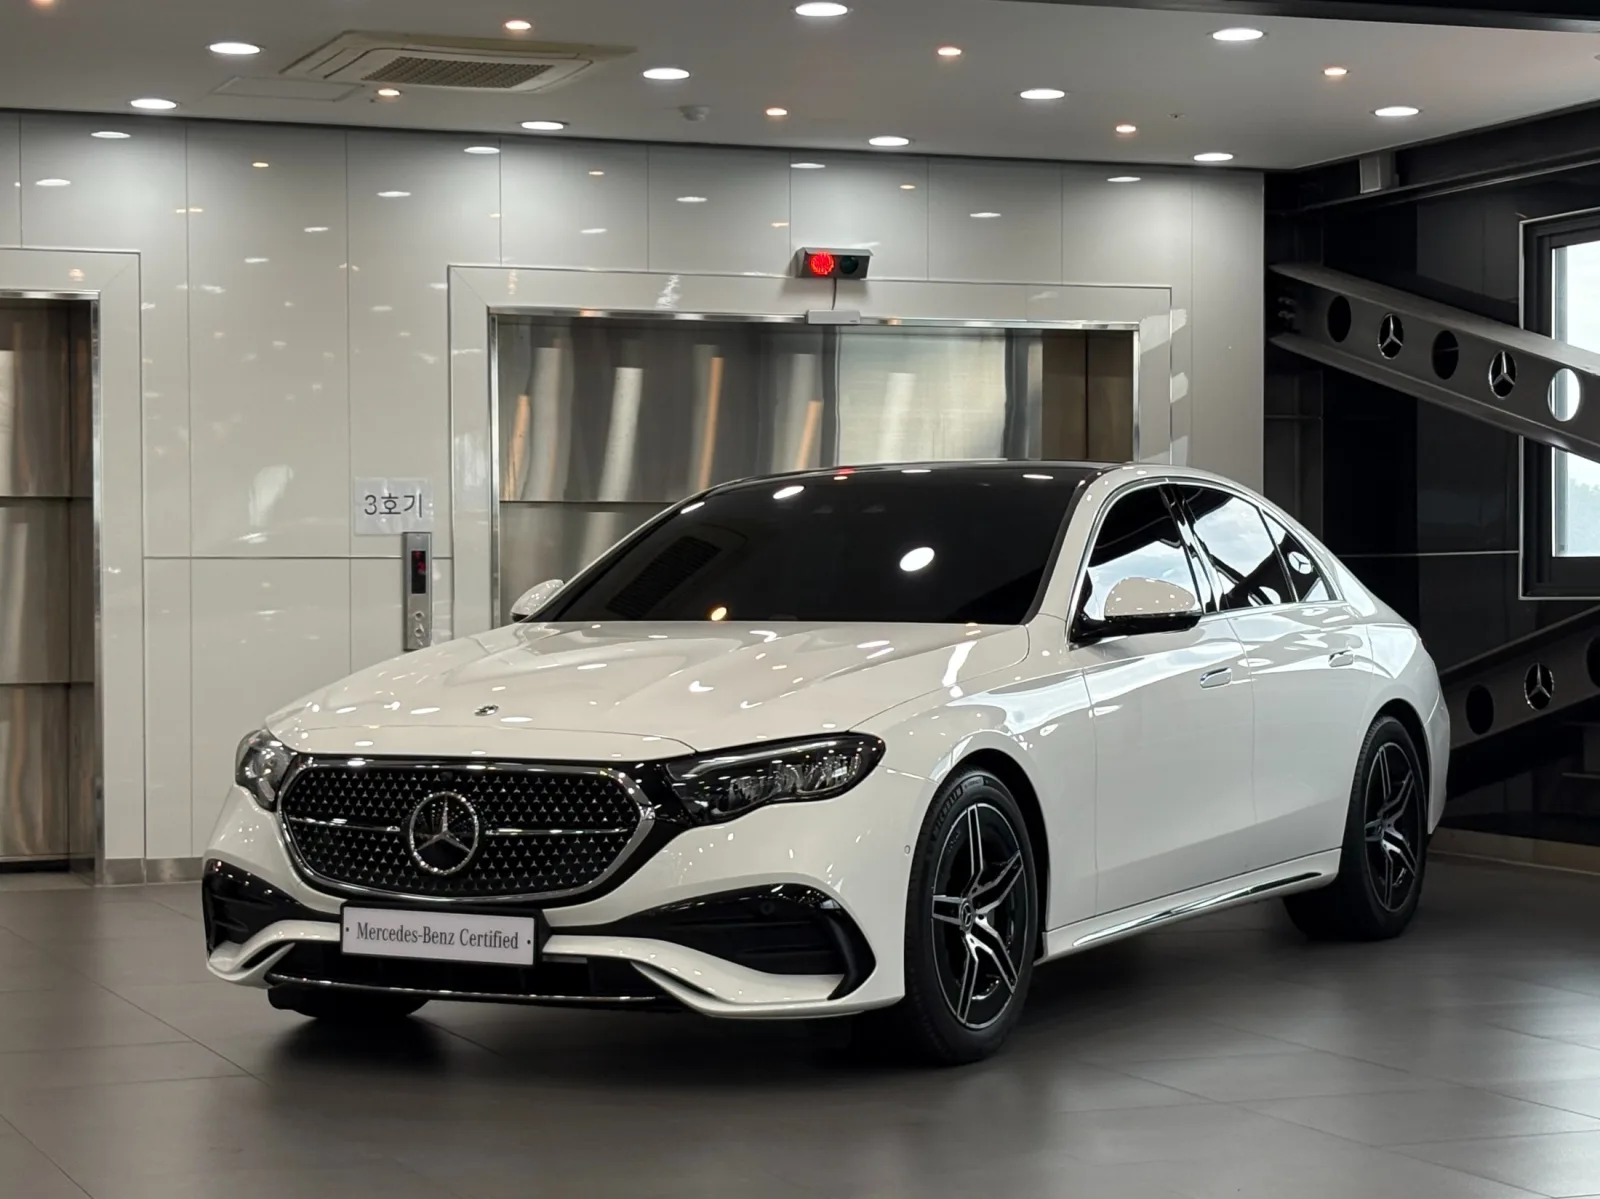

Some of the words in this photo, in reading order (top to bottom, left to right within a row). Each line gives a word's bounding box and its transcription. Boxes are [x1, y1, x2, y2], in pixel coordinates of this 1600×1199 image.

[364, 493, 422, 518] 3호기
[356, 921, 455, 946] Mercedes-Benz
[459, 927, 519, 949] Certified
